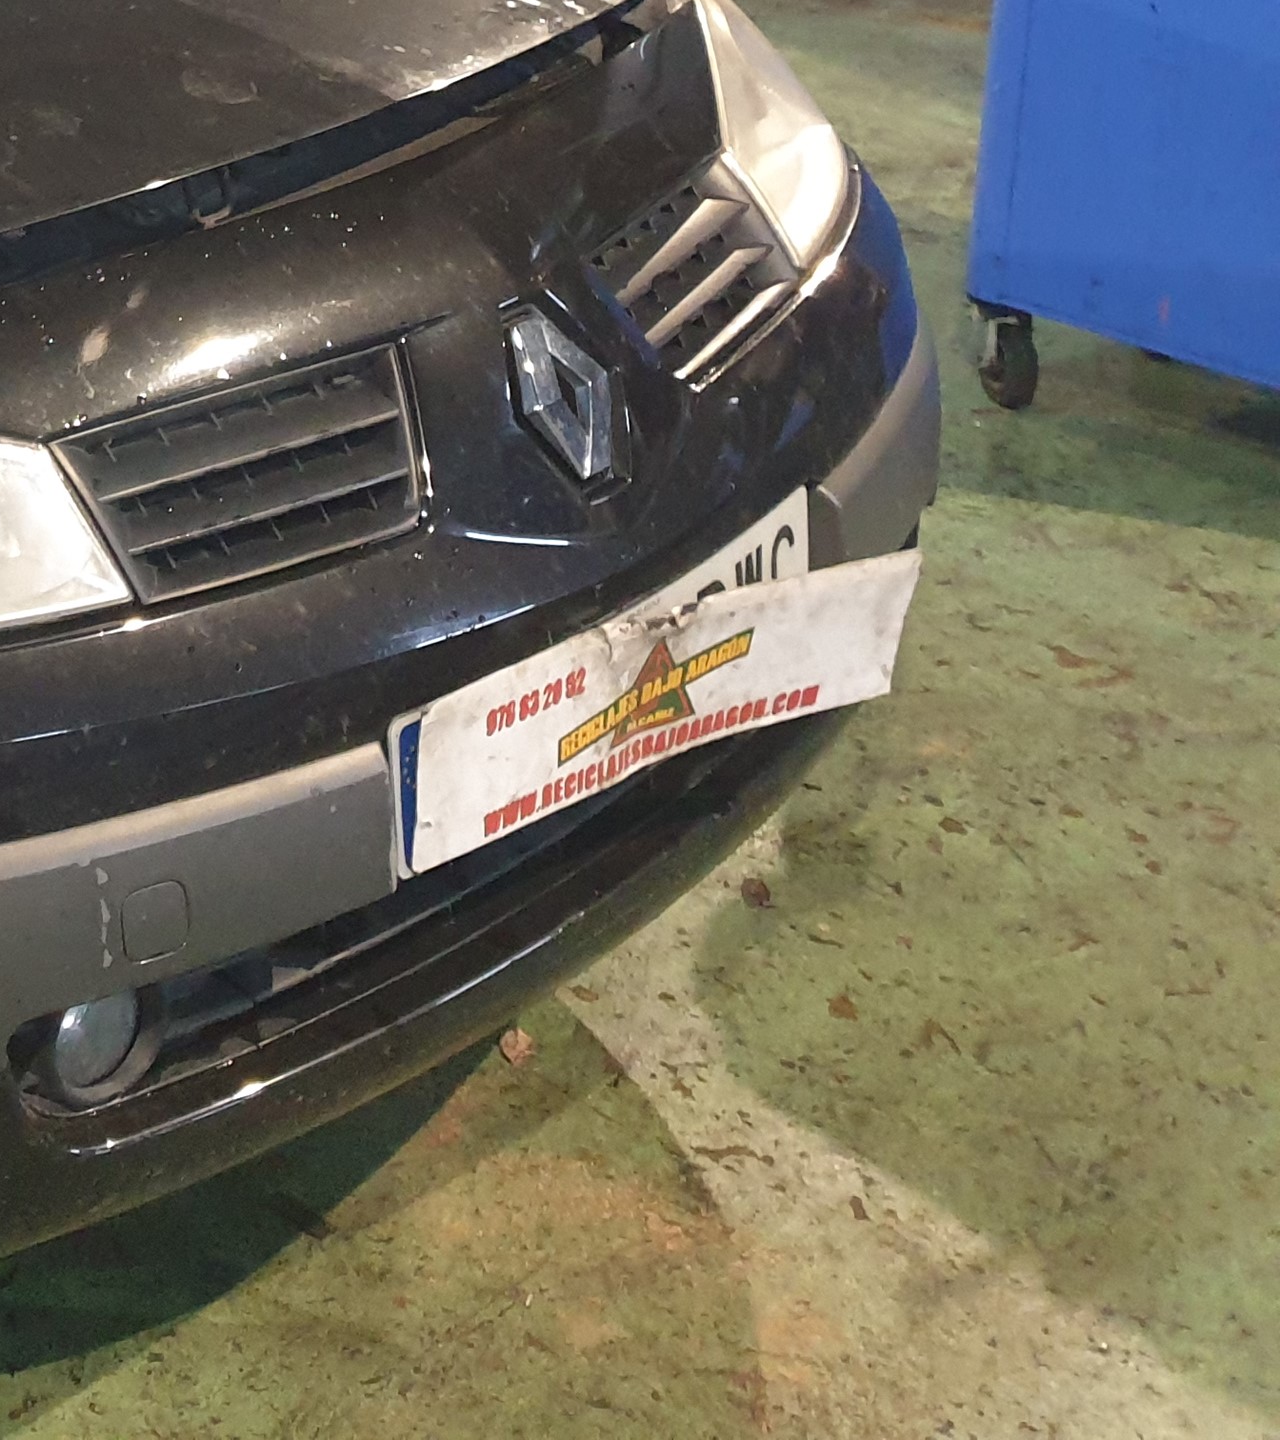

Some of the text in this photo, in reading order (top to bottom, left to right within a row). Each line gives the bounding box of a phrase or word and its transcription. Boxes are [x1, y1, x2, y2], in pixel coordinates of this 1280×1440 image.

[542, 677, 563, 711] 20
[560, 688, 638, 759] RECICLAJES
[640, 666, 683, 706] BAJO
